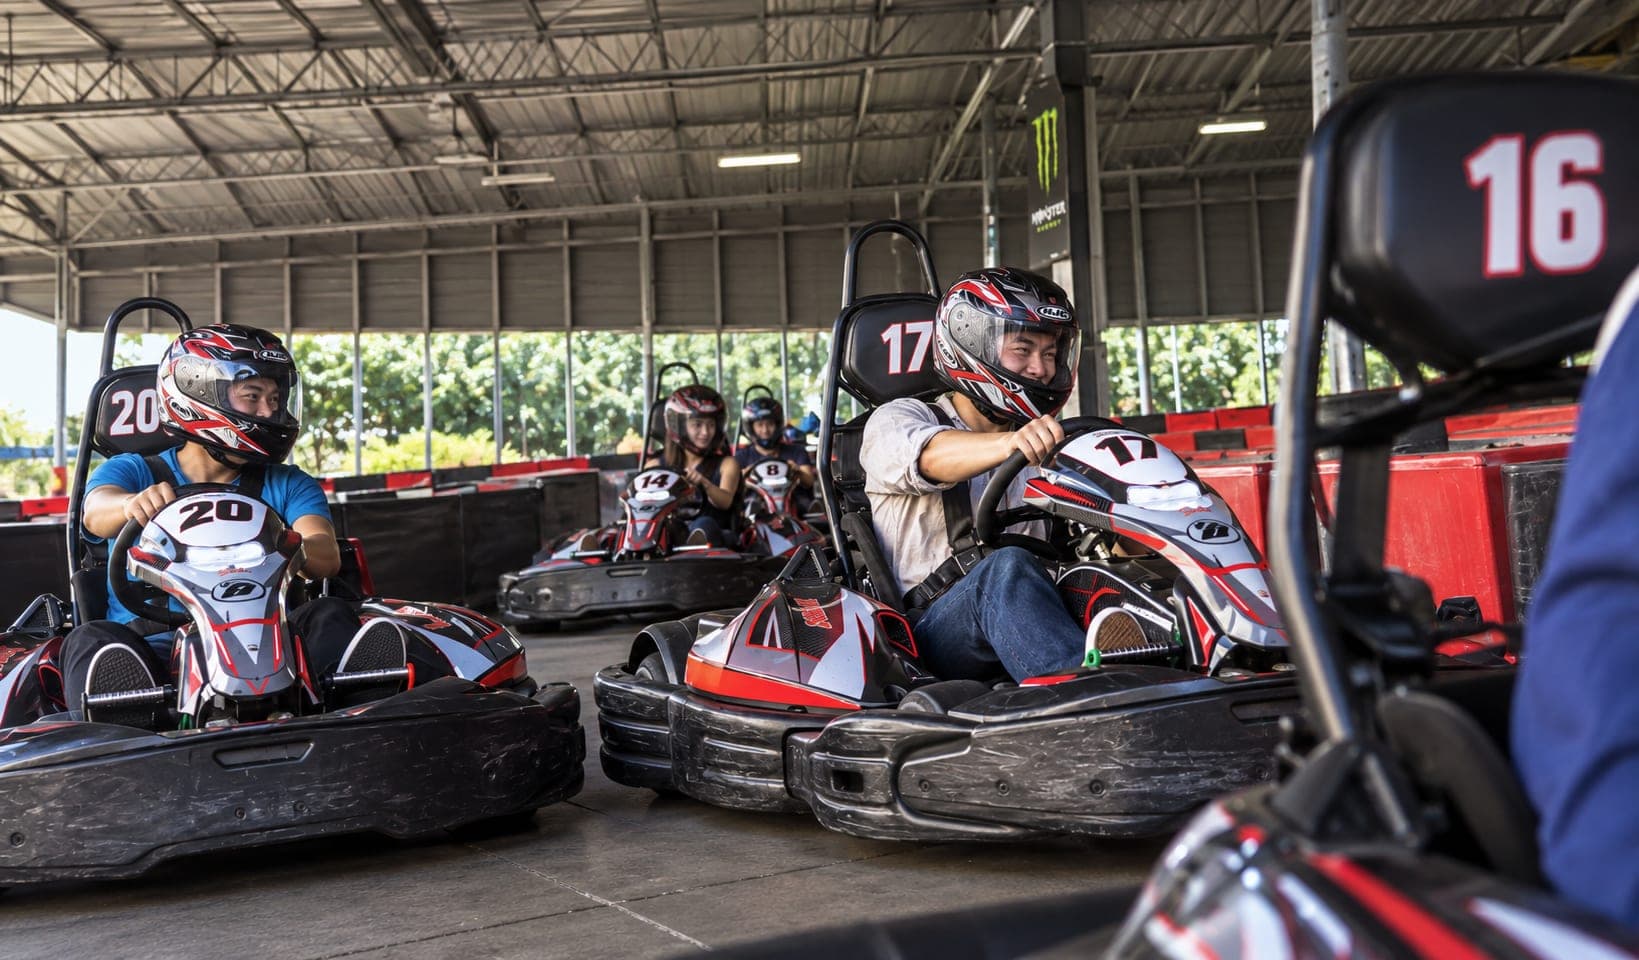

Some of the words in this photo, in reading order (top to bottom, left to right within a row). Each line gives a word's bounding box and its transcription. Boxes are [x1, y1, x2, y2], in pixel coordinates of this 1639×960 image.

[1462, 129, 1607, 279] 16
[880, 320, 934, 375] 17
[109, 387, 160, 437] 20
[1093, 434, 1159, 467] 17
[641, 473, 670, 489] 14
[766, 464, 780, 476] 8
[178, 499, 254, 533] 20
